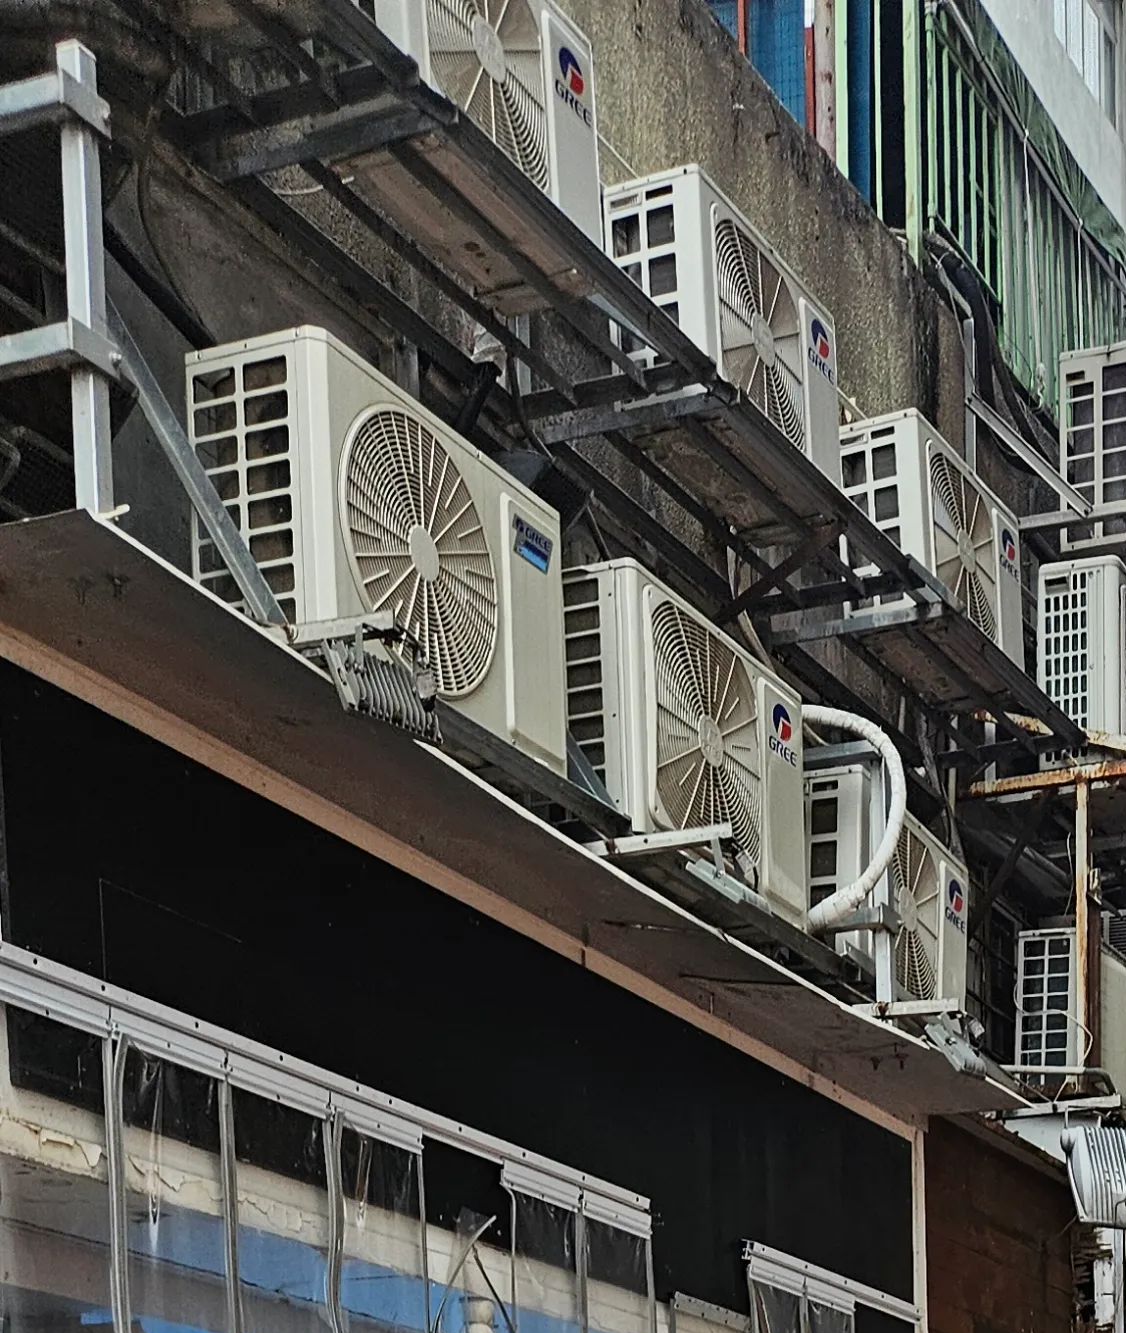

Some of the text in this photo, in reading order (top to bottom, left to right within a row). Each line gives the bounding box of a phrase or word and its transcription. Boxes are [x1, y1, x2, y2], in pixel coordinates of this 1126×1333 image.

[555, 79, 592, 128] GREE
[808, 347, 834, 386] GREE
[768, 735, 798, 768] GREE
[945, 906, 966, 934] GREE
